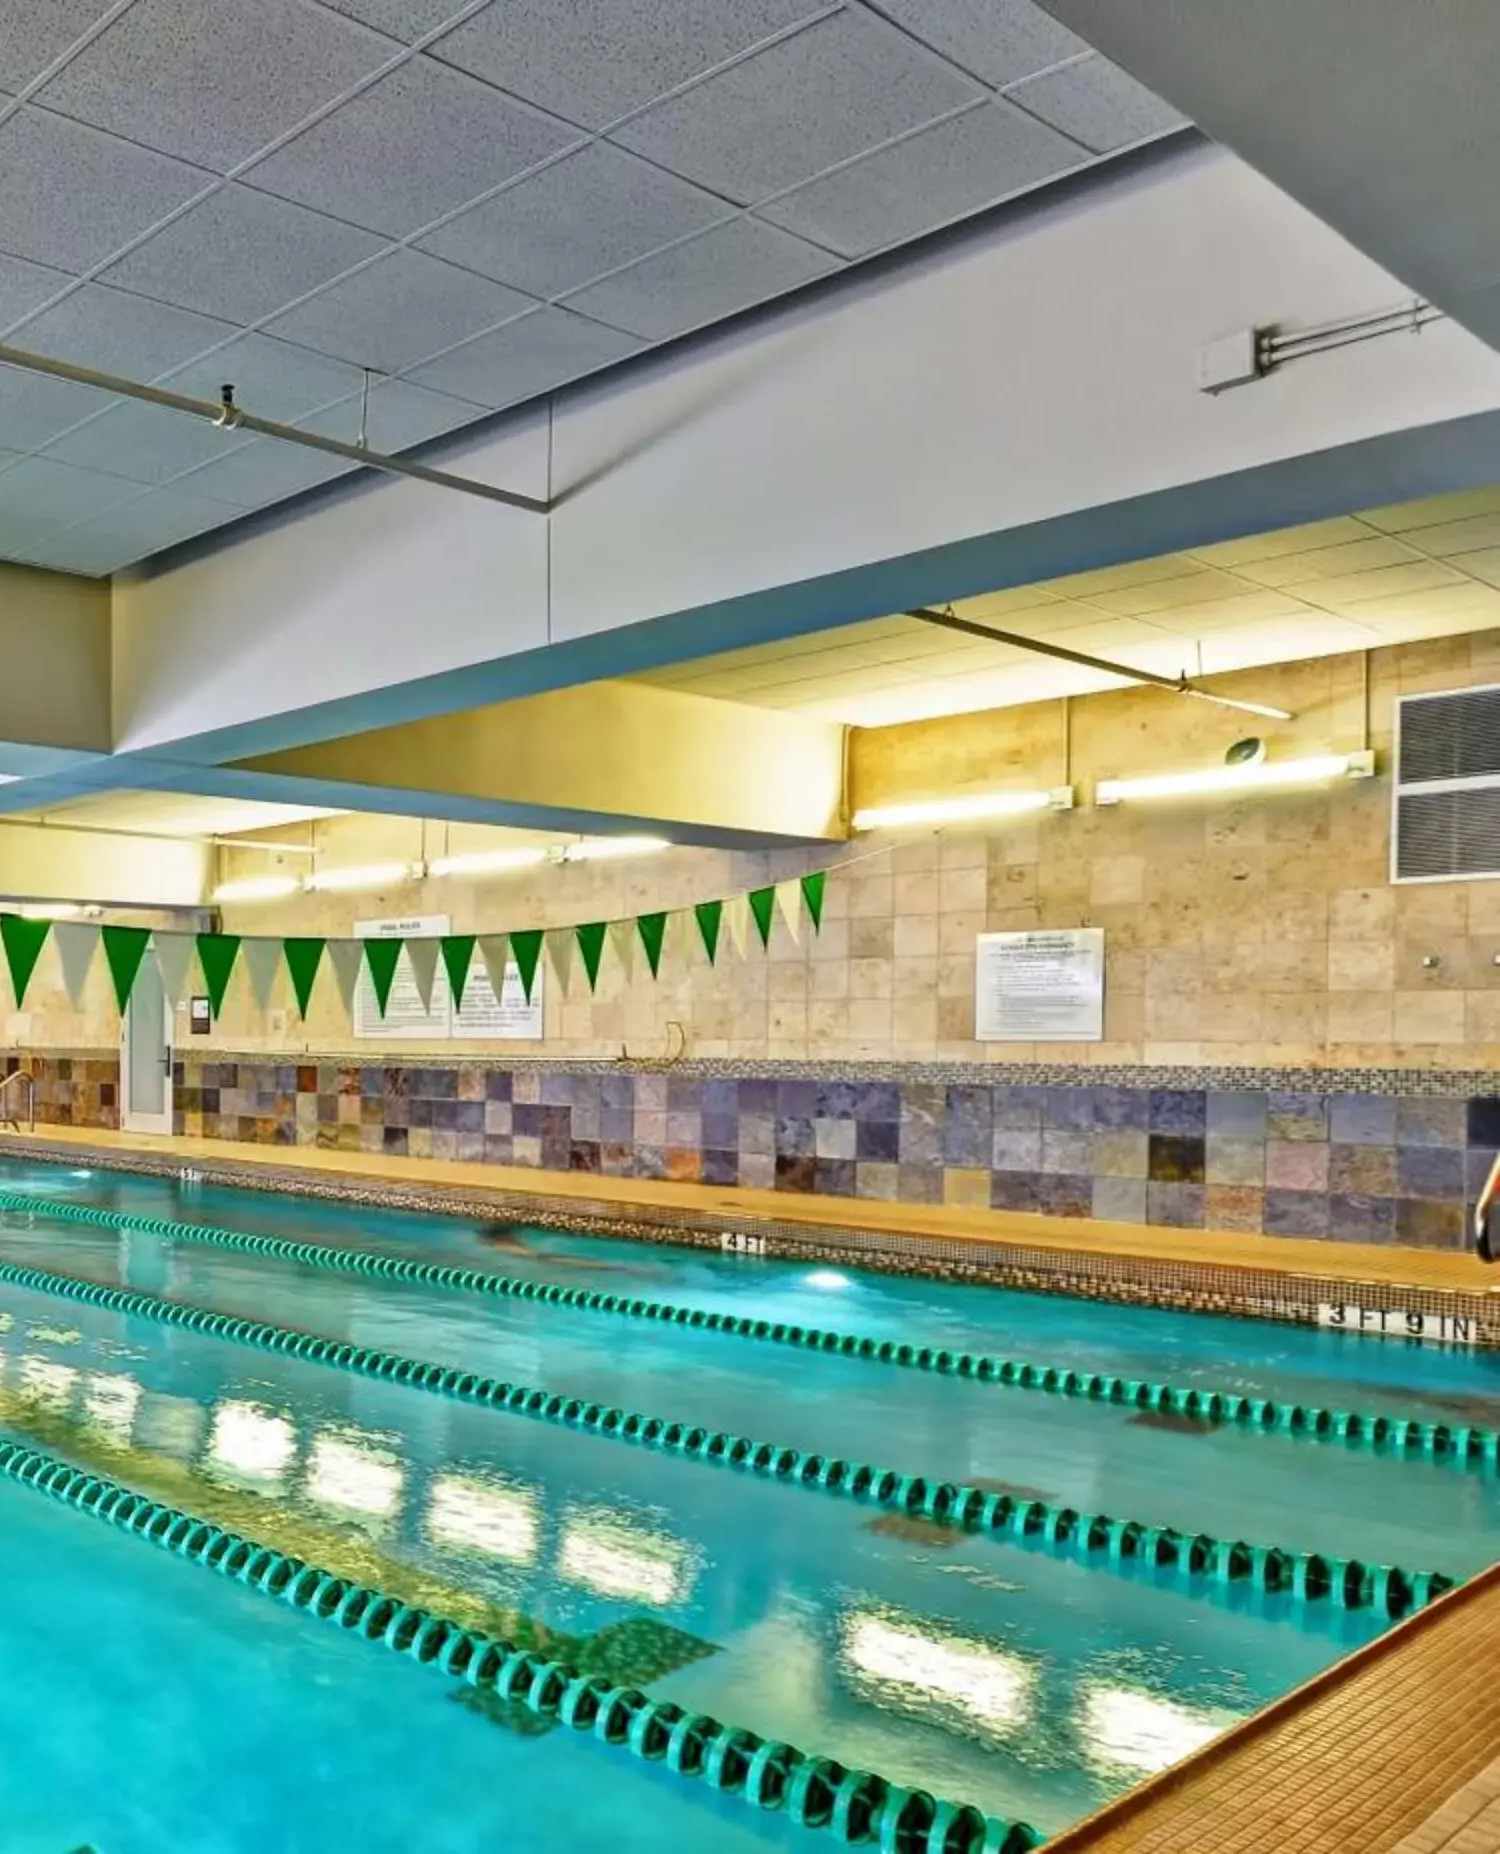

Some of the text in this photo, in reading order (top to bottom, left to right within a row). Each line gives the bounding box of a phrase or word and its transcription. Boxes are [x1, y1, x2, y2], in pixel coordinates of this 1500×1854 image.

[727, 1232, 737, 1249] 4
[1329, 1302, 1470, 1341] 3 FT 9 IN
